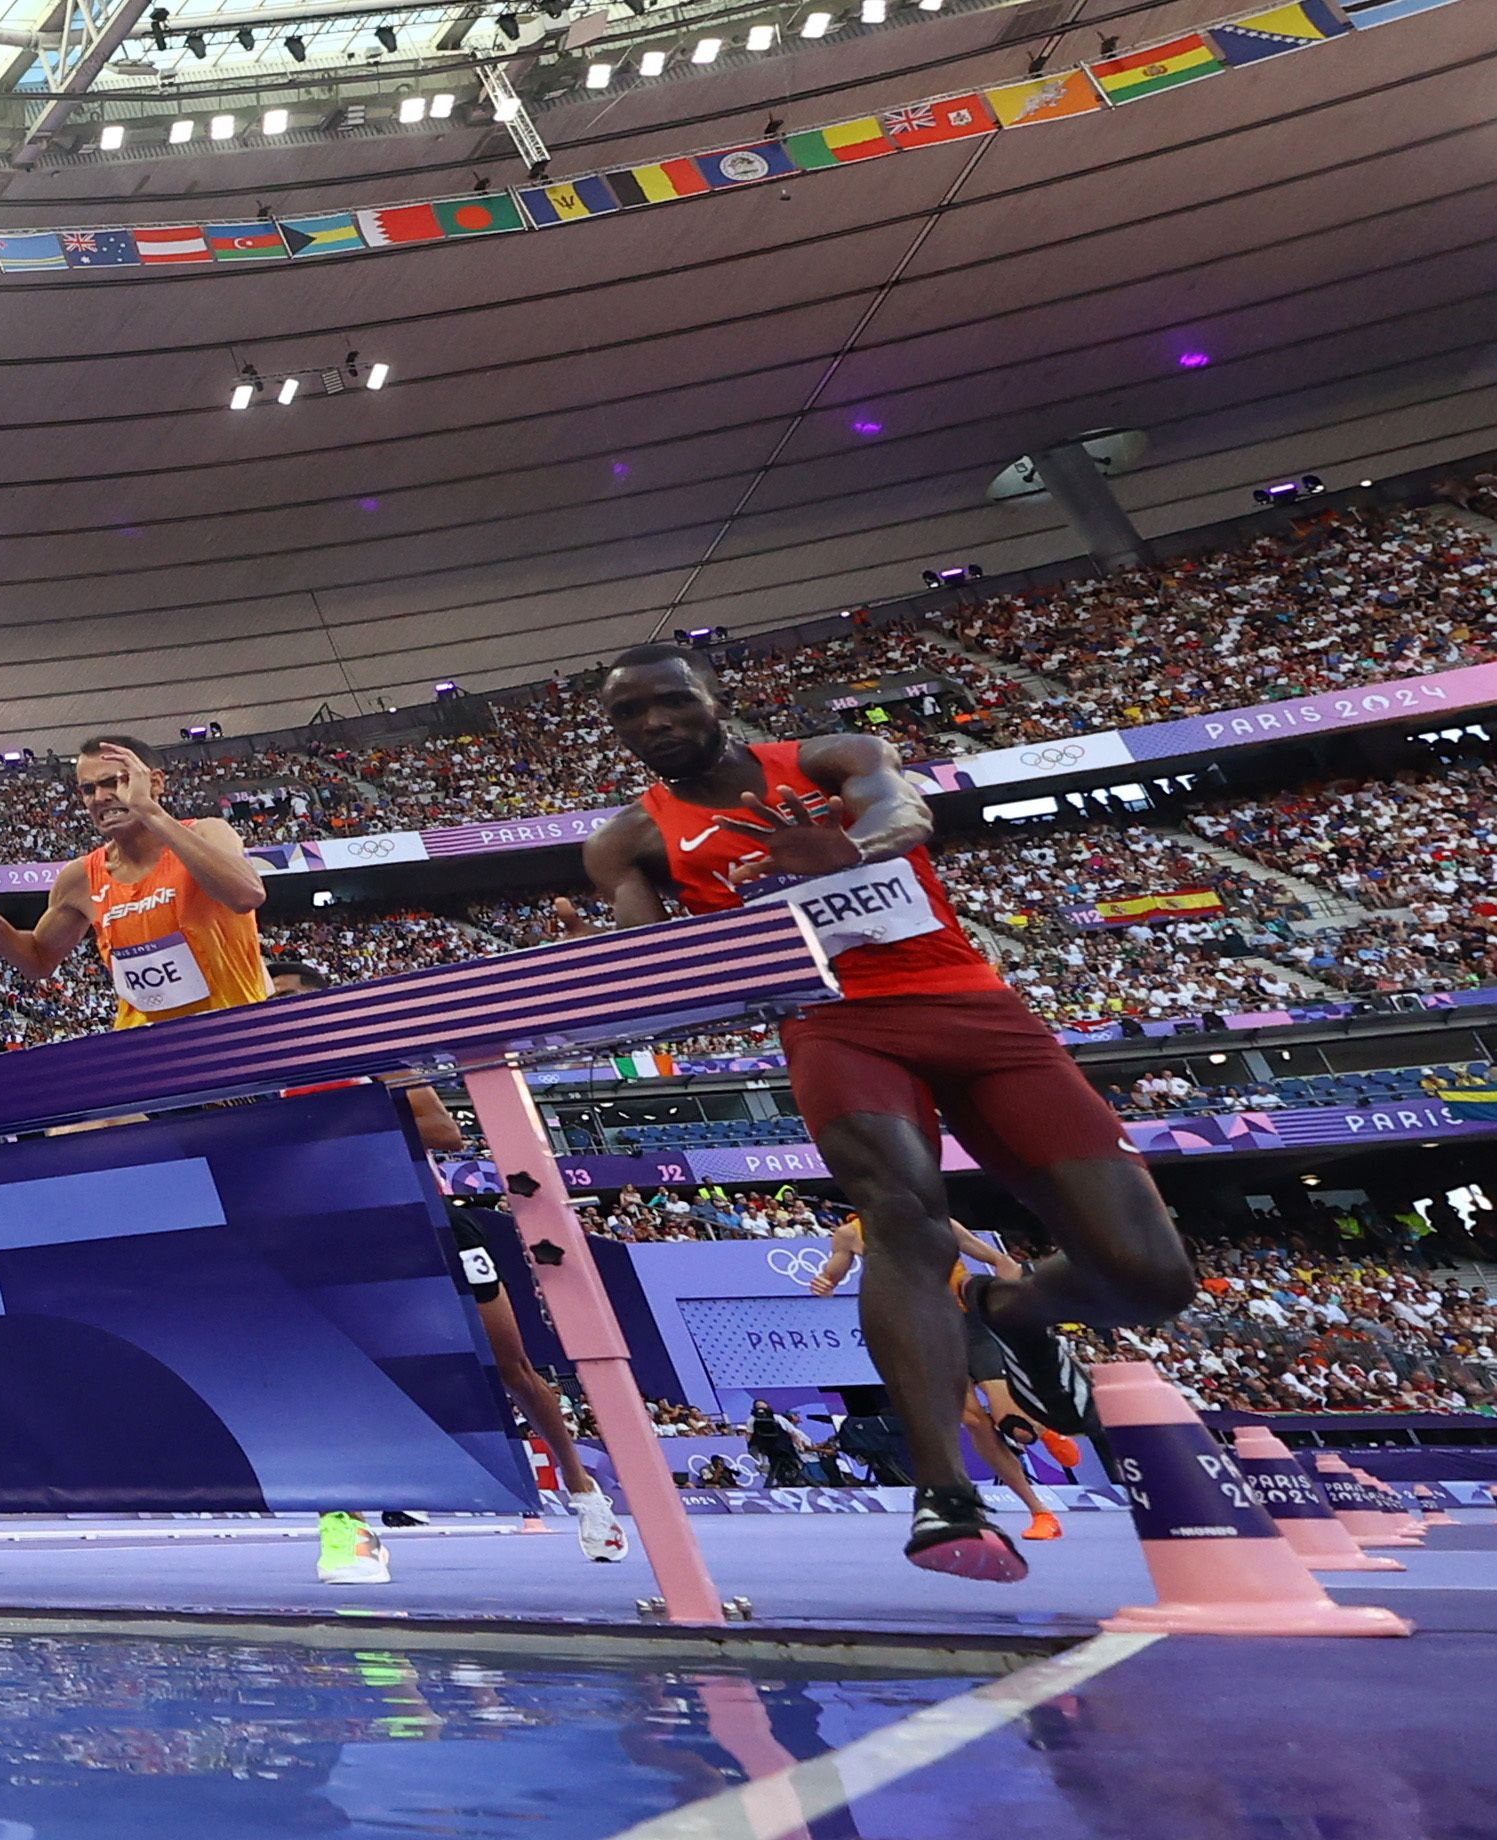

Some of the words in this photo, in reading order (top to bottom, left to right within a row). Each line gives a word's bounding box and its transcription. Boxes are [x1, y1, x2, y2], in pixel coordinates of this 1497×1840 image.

[1205, 706, 1322, 740] PARIS
[1335, 685, 1447, 718] 2024
[481, 824, 562, 844] PARIS
[9, 869, 59, 885] 202
[800, 876, 912, 928] EREM
[125, 961, 182, 990] RCE
[1345, 1107, 1463, 1133] PARIS
[473, 1254, 490, 1276] 3
[746, 1329, 841, 1352] PARIS
